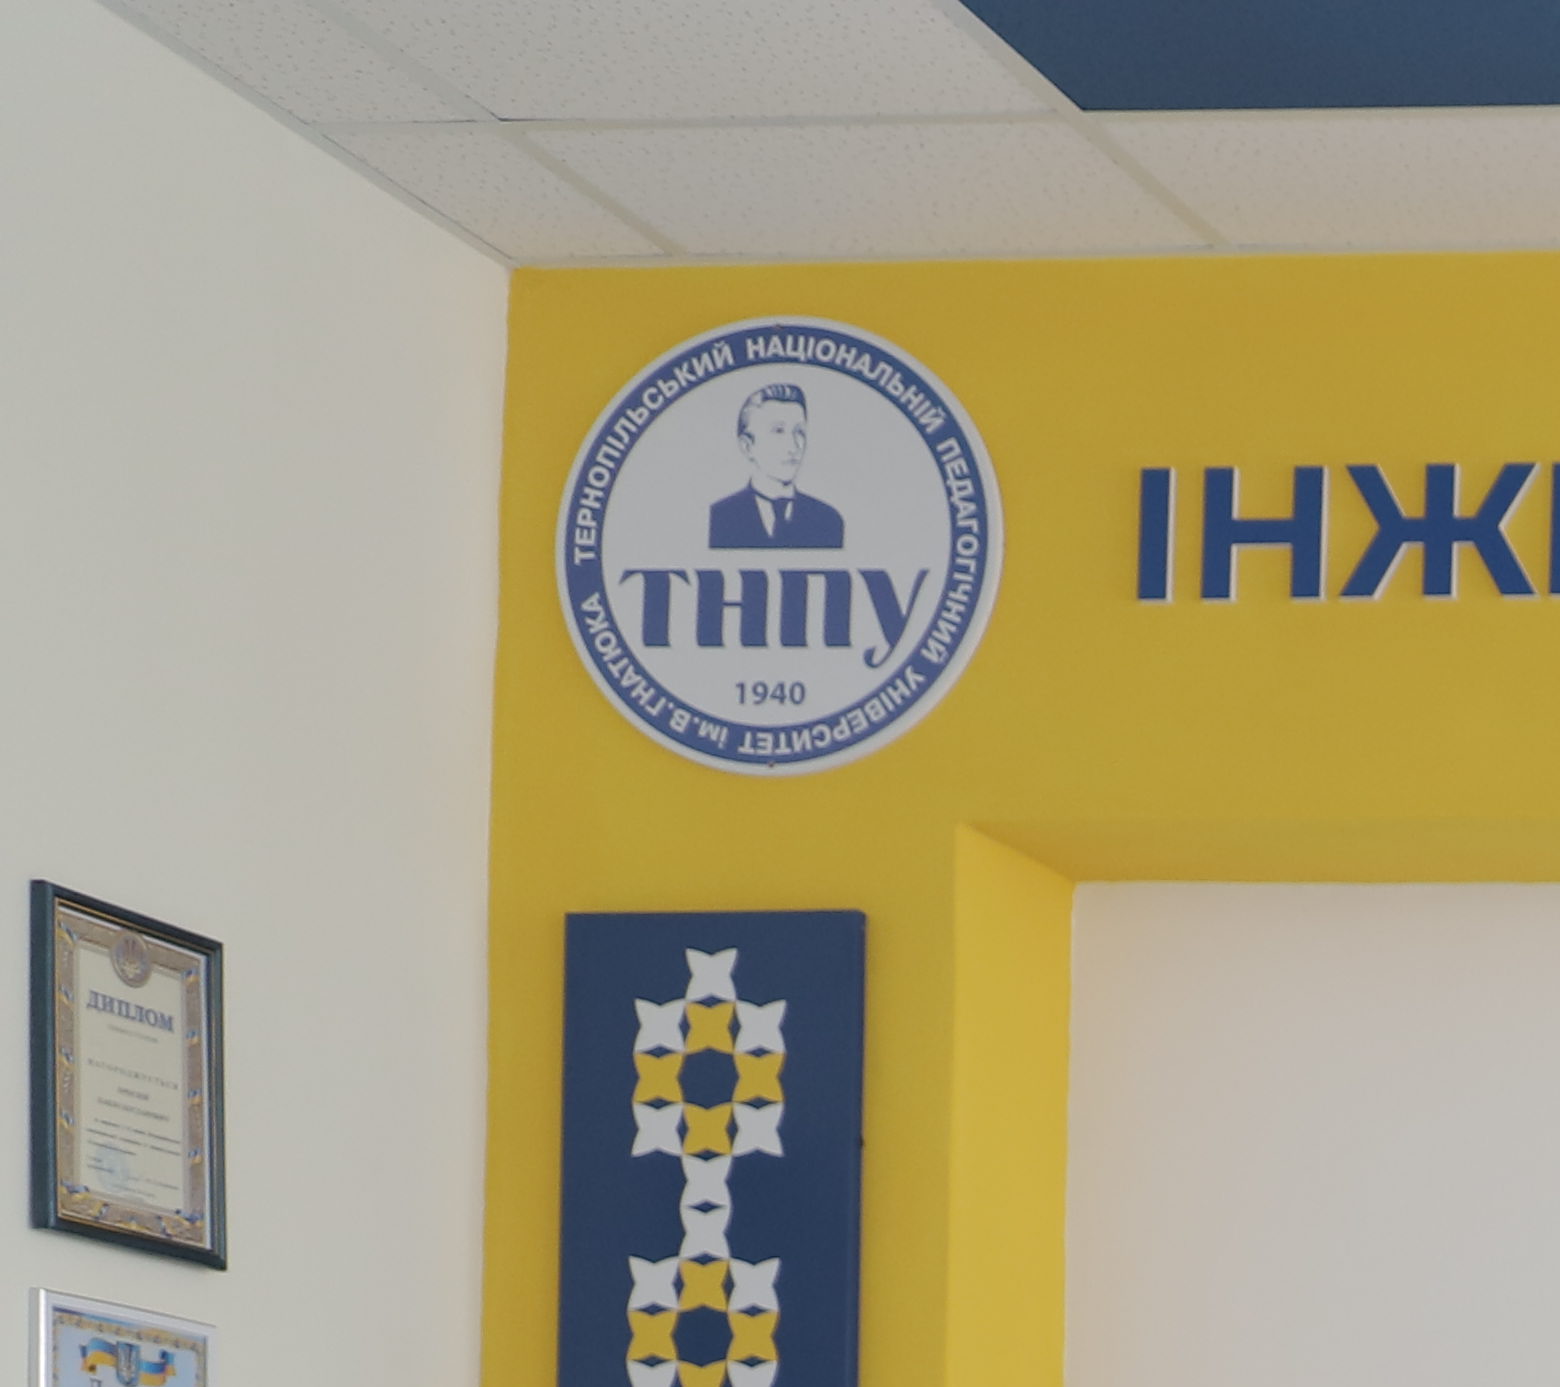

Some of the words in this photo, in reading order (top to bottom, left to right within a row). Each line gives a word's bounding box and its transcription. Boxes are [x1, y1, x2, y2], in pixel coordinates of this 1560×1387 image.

[574, 340, 735, 566] ТЕРНОПІЛЬСЬКИЙ
[920, 437, 980, 665] ПЕДАГОГІЧНИЙ
[618, 569, 930, 668] ТНПУ
[735, 681, 806, 705] 1940
[737, 665, 926, 756] УНІВЕРСИТЕТ
[86, 990, 174, 1032] ДИПЛОМ
